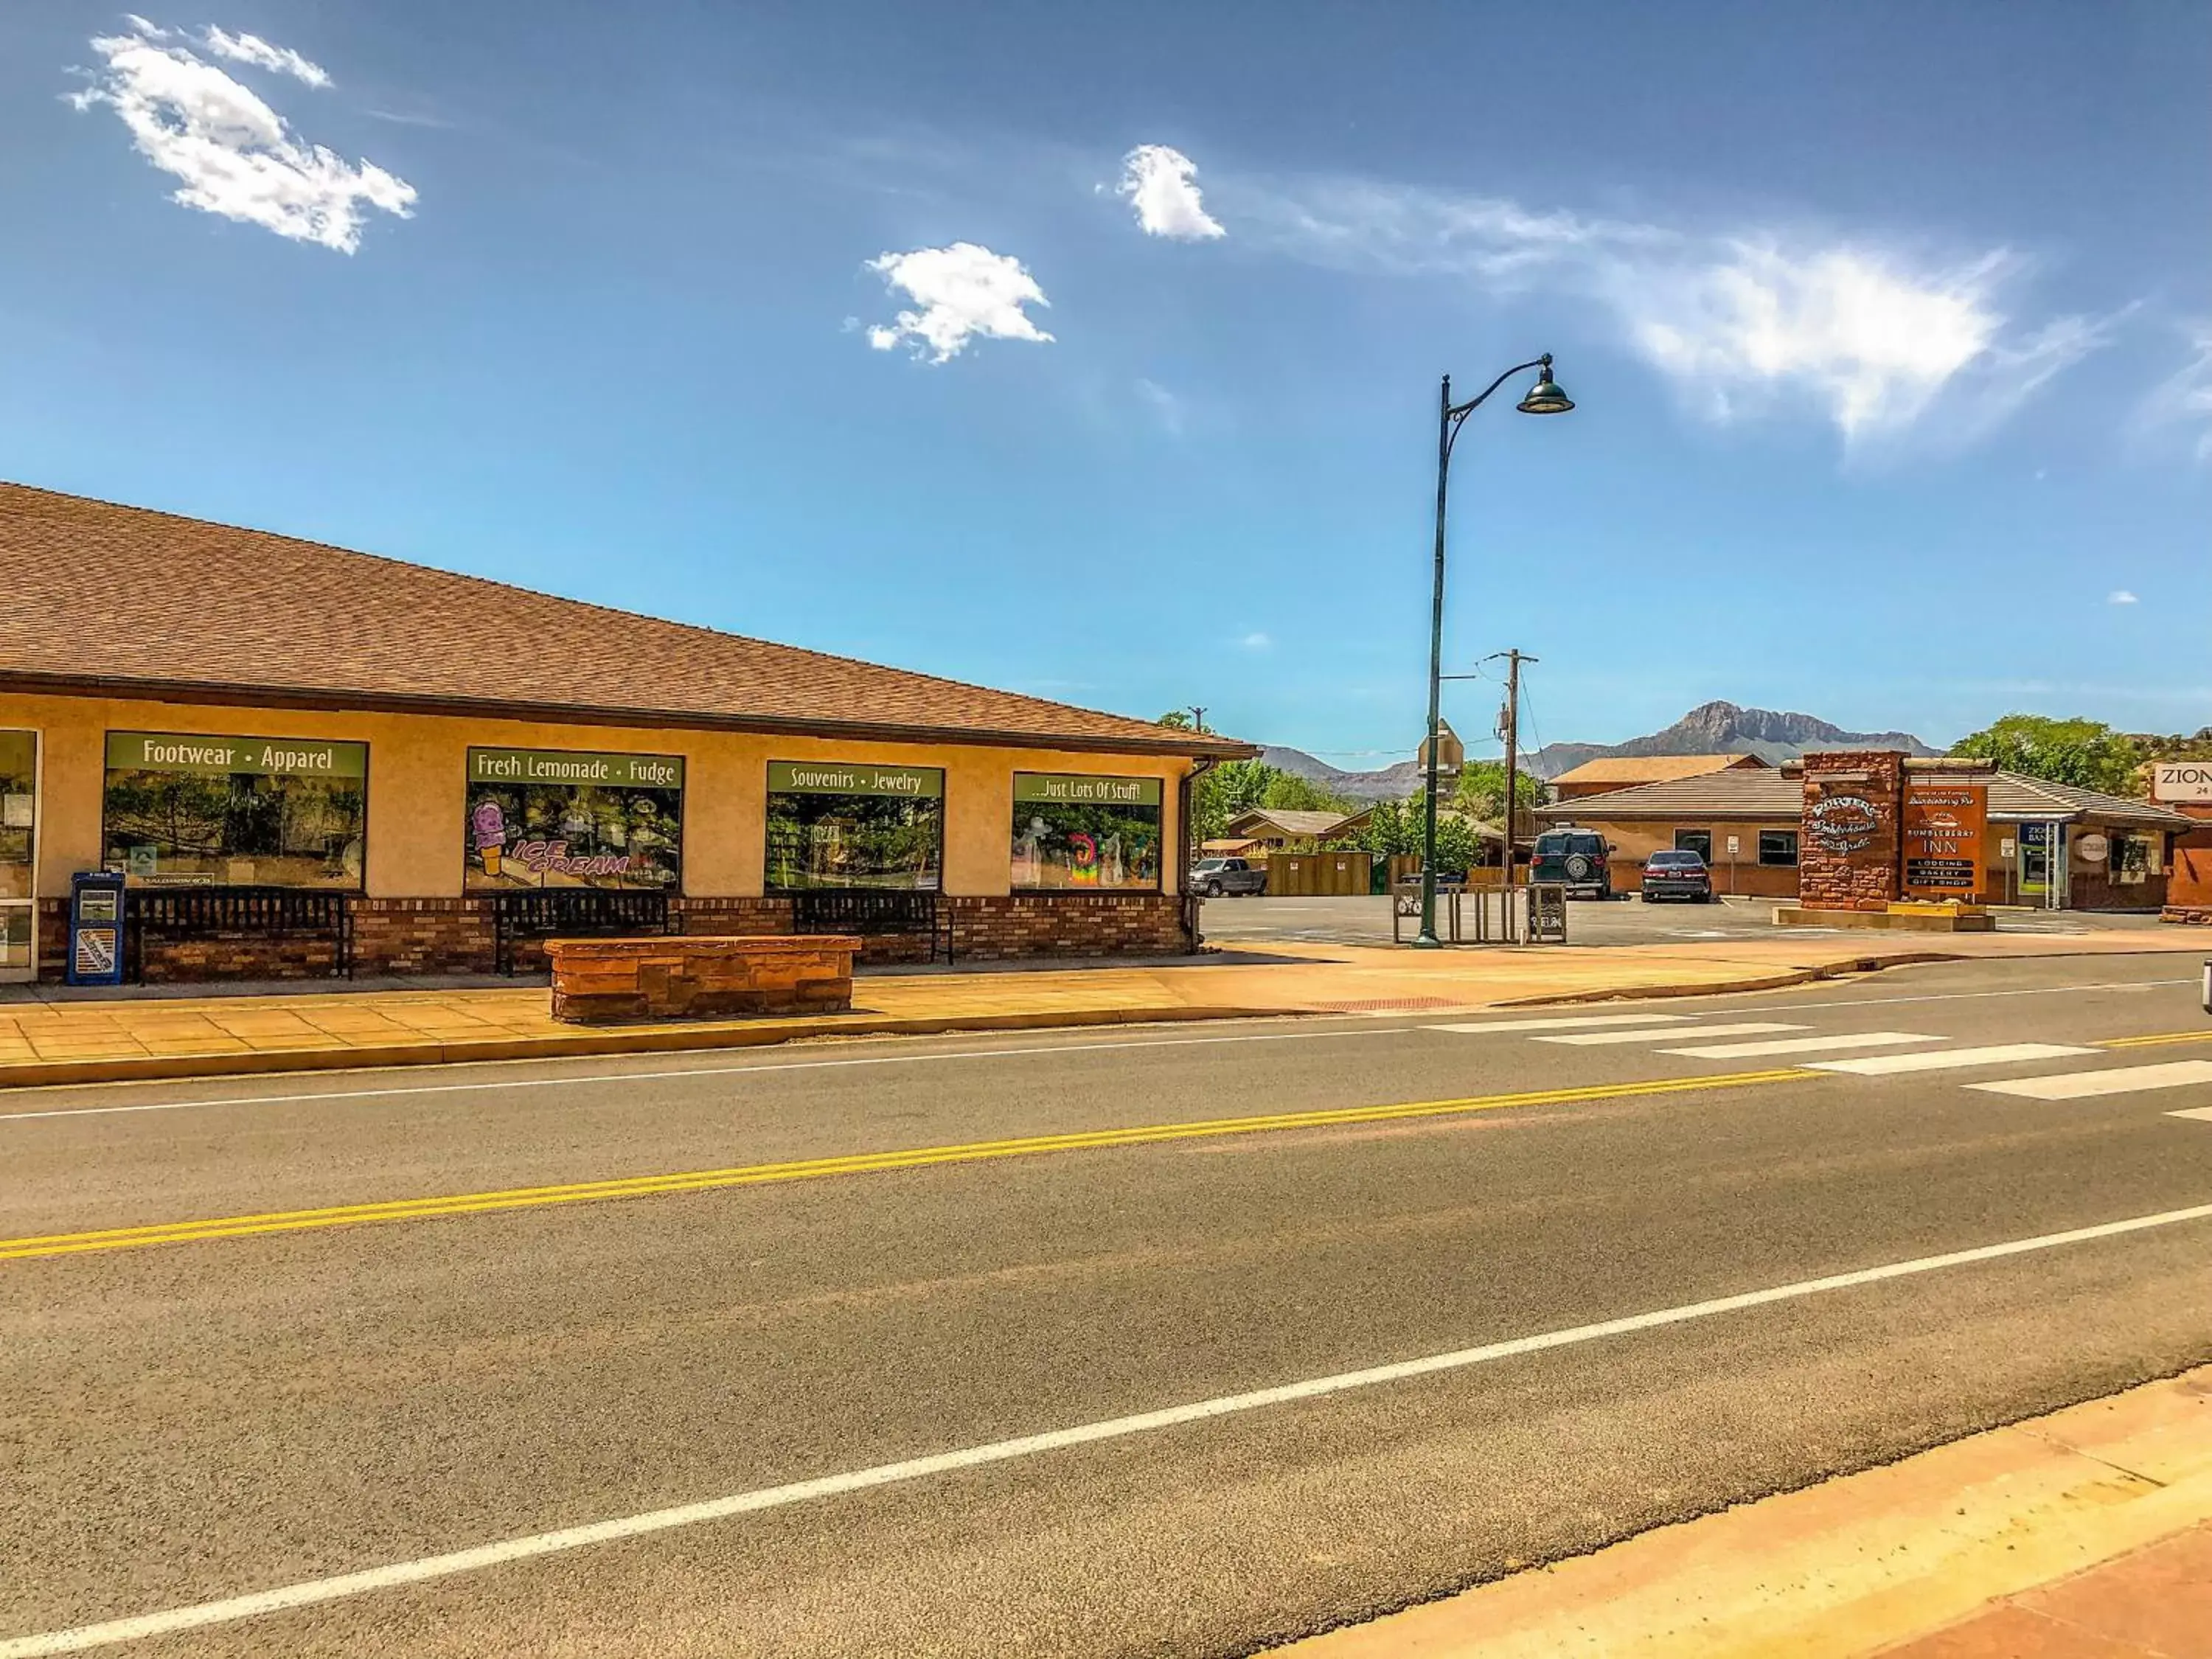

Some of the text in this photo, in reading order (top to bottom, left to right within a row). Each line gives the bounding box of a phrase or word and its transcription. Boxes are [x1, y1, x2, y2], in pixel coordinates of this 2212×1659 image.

[144, 740, 333, 771] Footwear Apparel
[479, 754, 675, 785] Fresh Lemonade Fudge
[791, 768, 921, 794] Souvenirs Jewelry
[1071, 781, 1093, 798] Lots
[1096, 782, 1110, 799] Of
[1112, 782, 1141, 801] Stuff!
[512, 840, 568, 861] ICE
[1924, 840, 1958, 853] INN
[526, 856, 630, 876] CREAM
